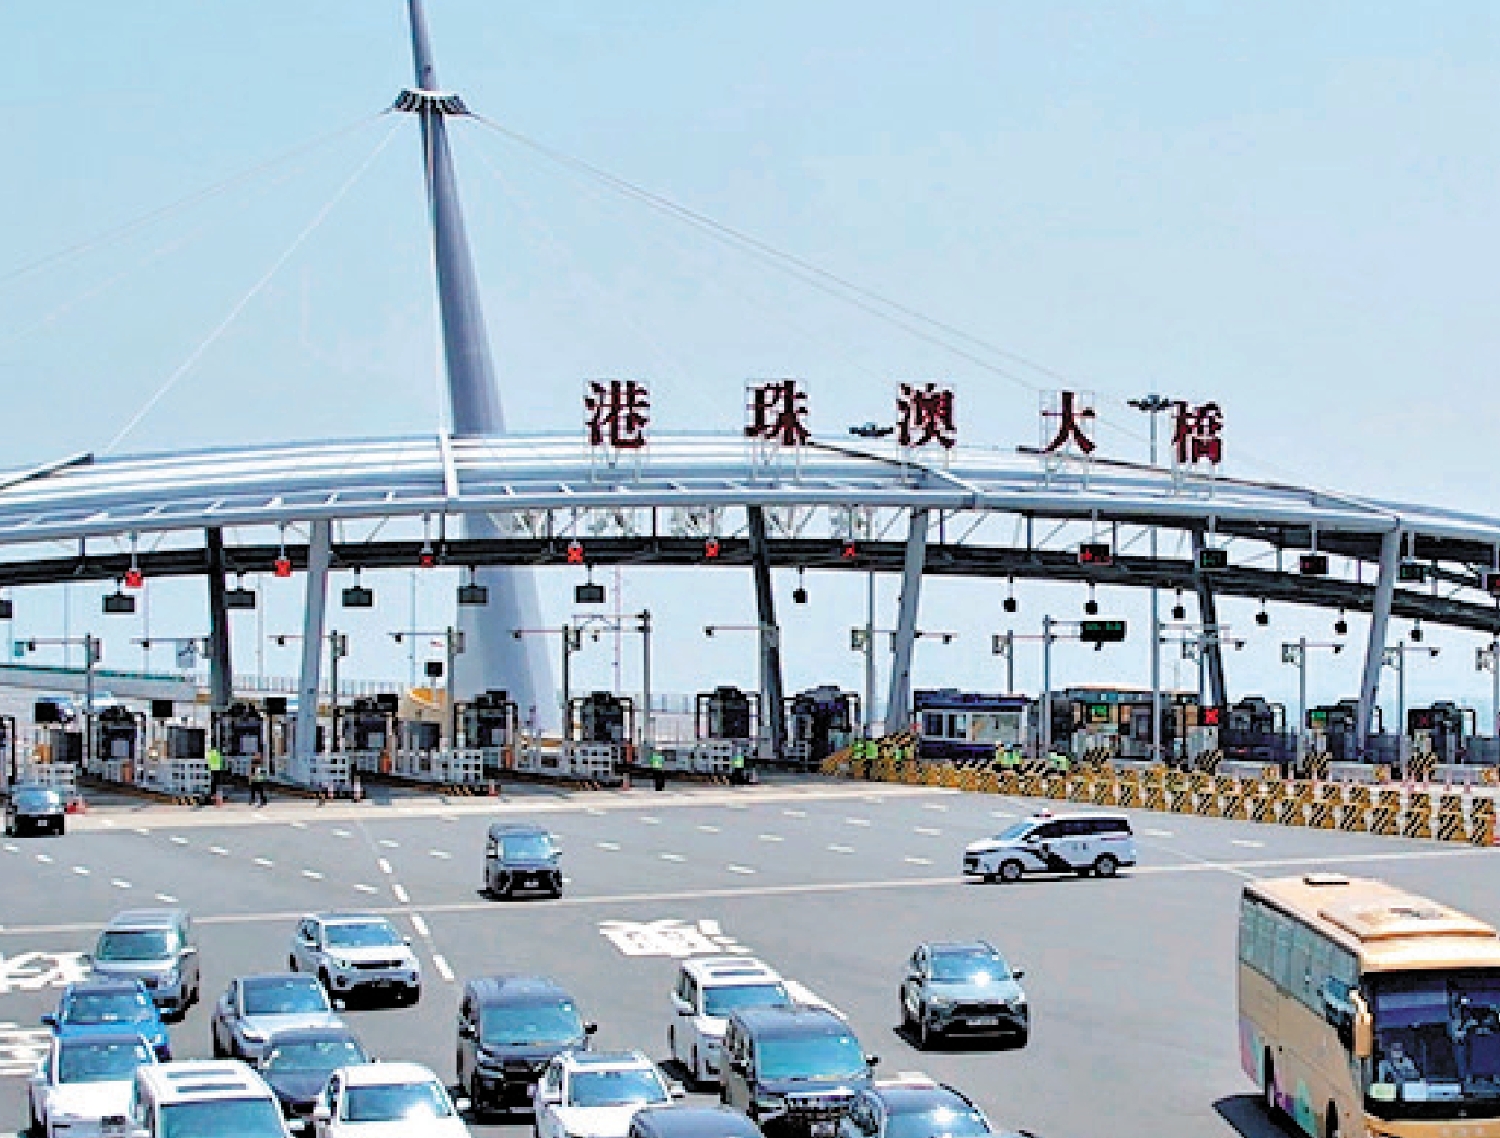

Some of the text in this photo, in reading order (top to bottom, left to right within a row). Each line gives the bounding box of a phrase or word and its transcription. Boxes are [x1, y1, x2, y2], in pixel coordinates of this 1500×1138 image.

[584, 380, 1226, 466] 港珠澳大橋
